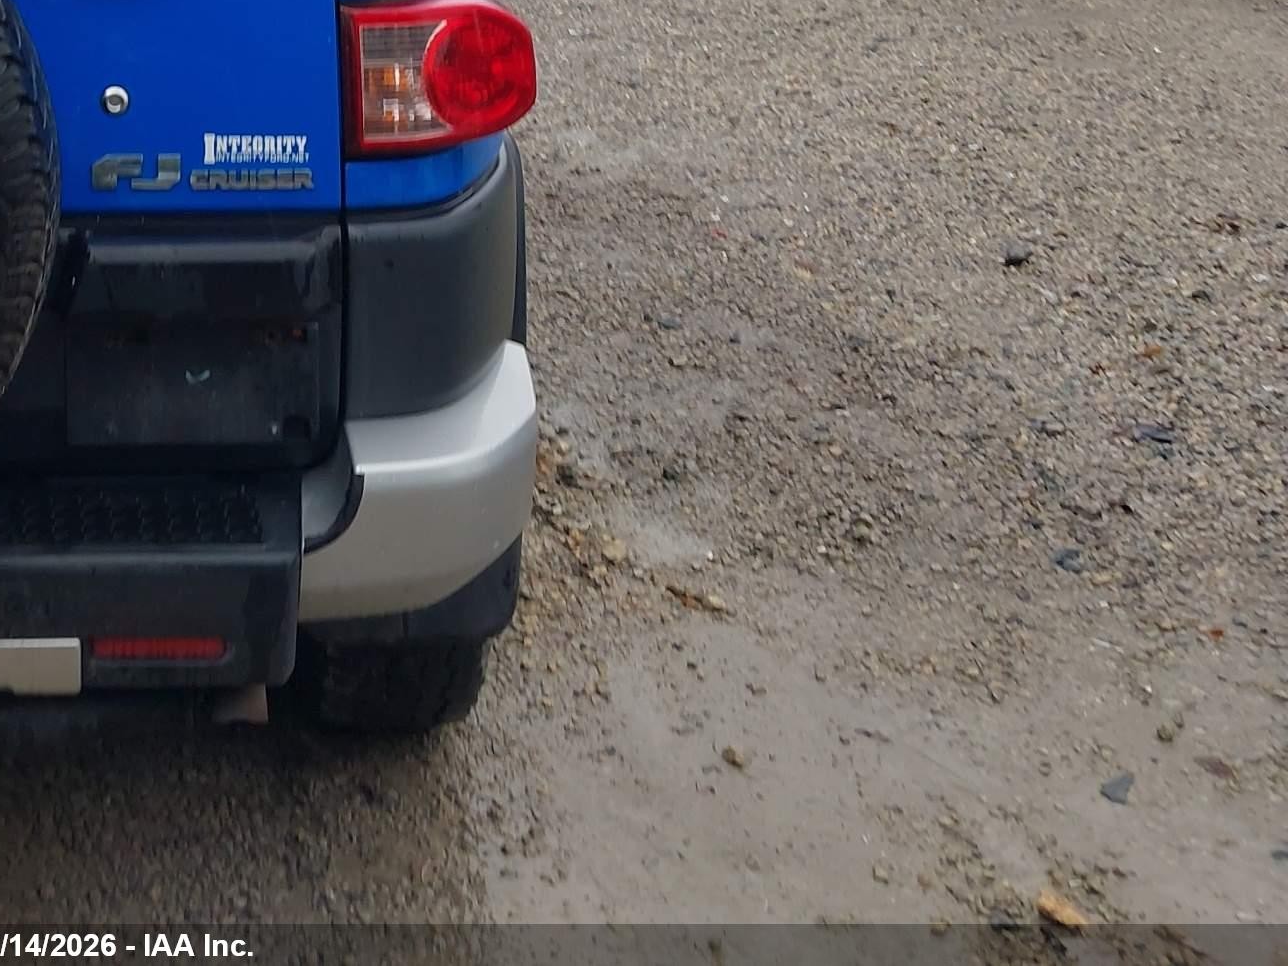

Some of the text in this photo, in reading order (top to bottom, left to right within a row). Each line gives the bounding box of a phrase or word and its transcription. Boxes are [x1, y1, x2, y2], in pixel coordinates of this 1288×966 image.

[203, 132, 309, 165] INTEGRITY
[92, 153, 315, 192] FJ CRUISER
